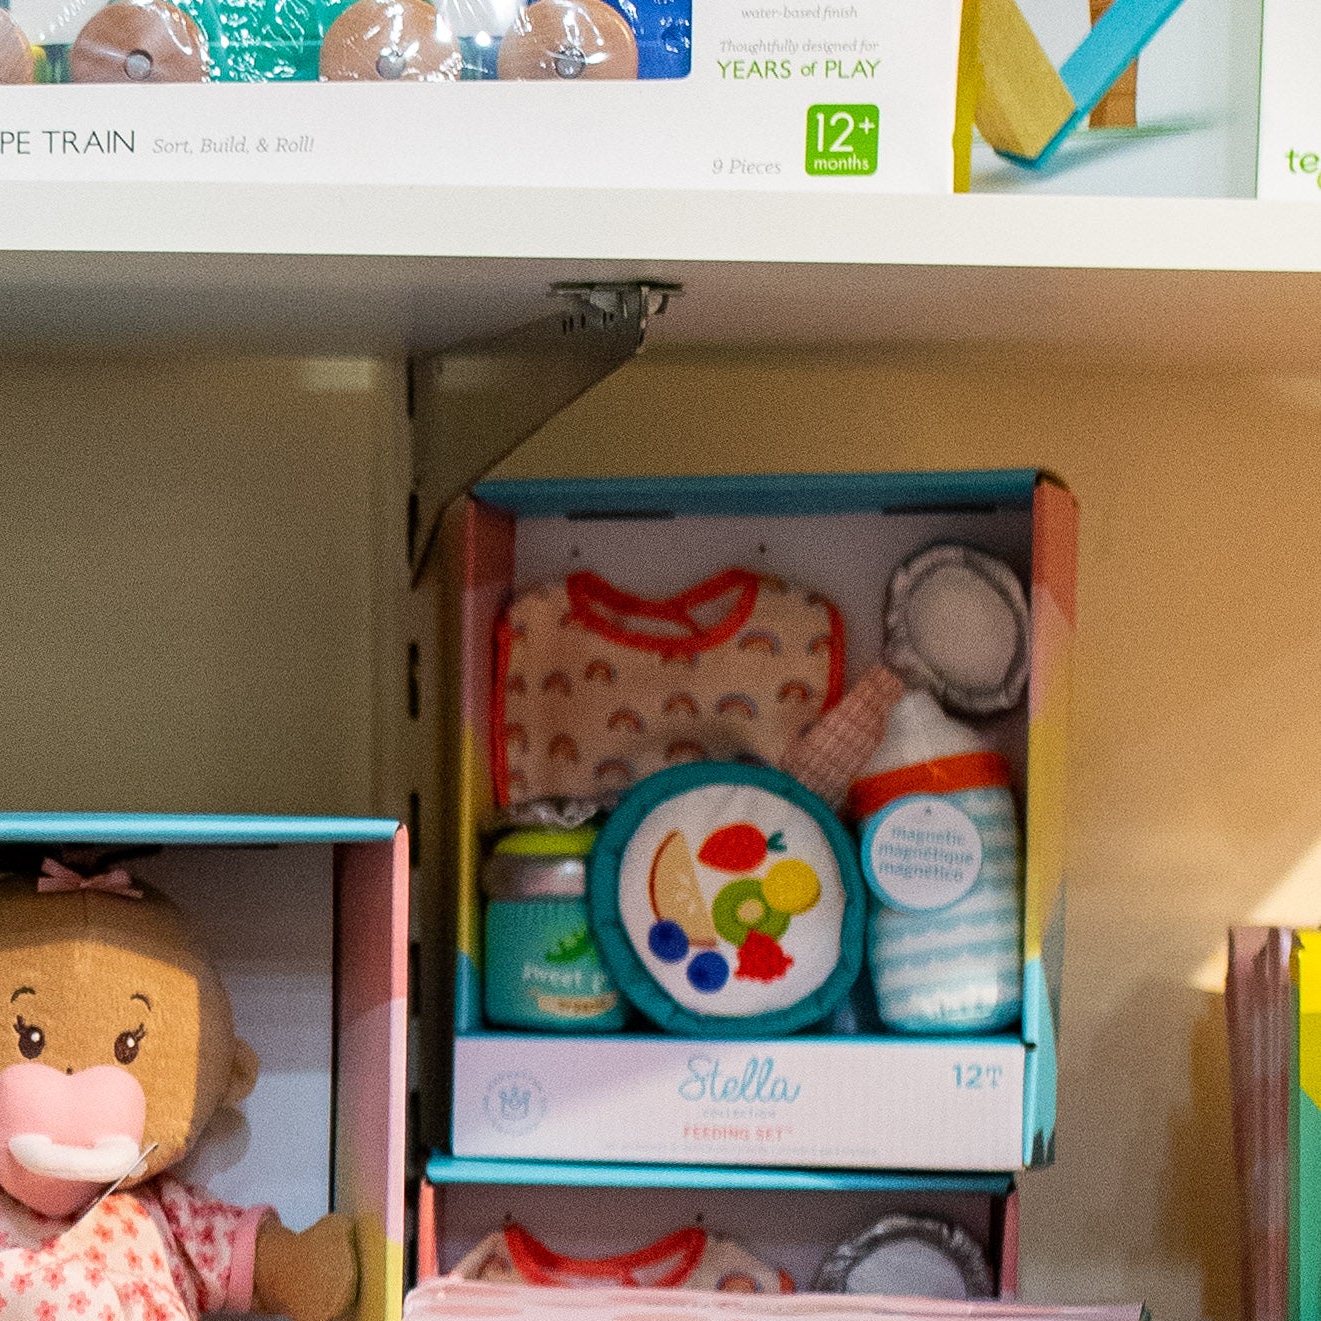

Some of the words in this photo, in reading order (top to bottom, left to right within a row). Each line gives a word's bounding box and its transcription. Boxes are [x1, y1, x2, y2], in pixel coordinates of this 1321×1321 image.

[741, 6, 820, 20] water-based
[823, 5, 858, 21] finish
[720, 39, 799, 55] Thoughtfully
[802, 39, 857, 55] designed
[859, 40, 879, 55] for
[717, 59, 792, 79] YEARS
[801, 61, 817, 77] of
[825, 59, 881, 79] PLAY
[43, 130, 135, 155] TRAIN
[152, 137, 193, 155] Sort,
[201, 136, 249, 155] Build,
[257, 137, 268, 153] &
[276, 136, 314, 153] Roll!
[712, 158, 724, 174] 9
[729, 157, 782, 175] Pieces
[814, 154, 870, 173] months
[679, 1054, 800, 1104] Stella
[684, 1126, 749, 1141] FEEDING
